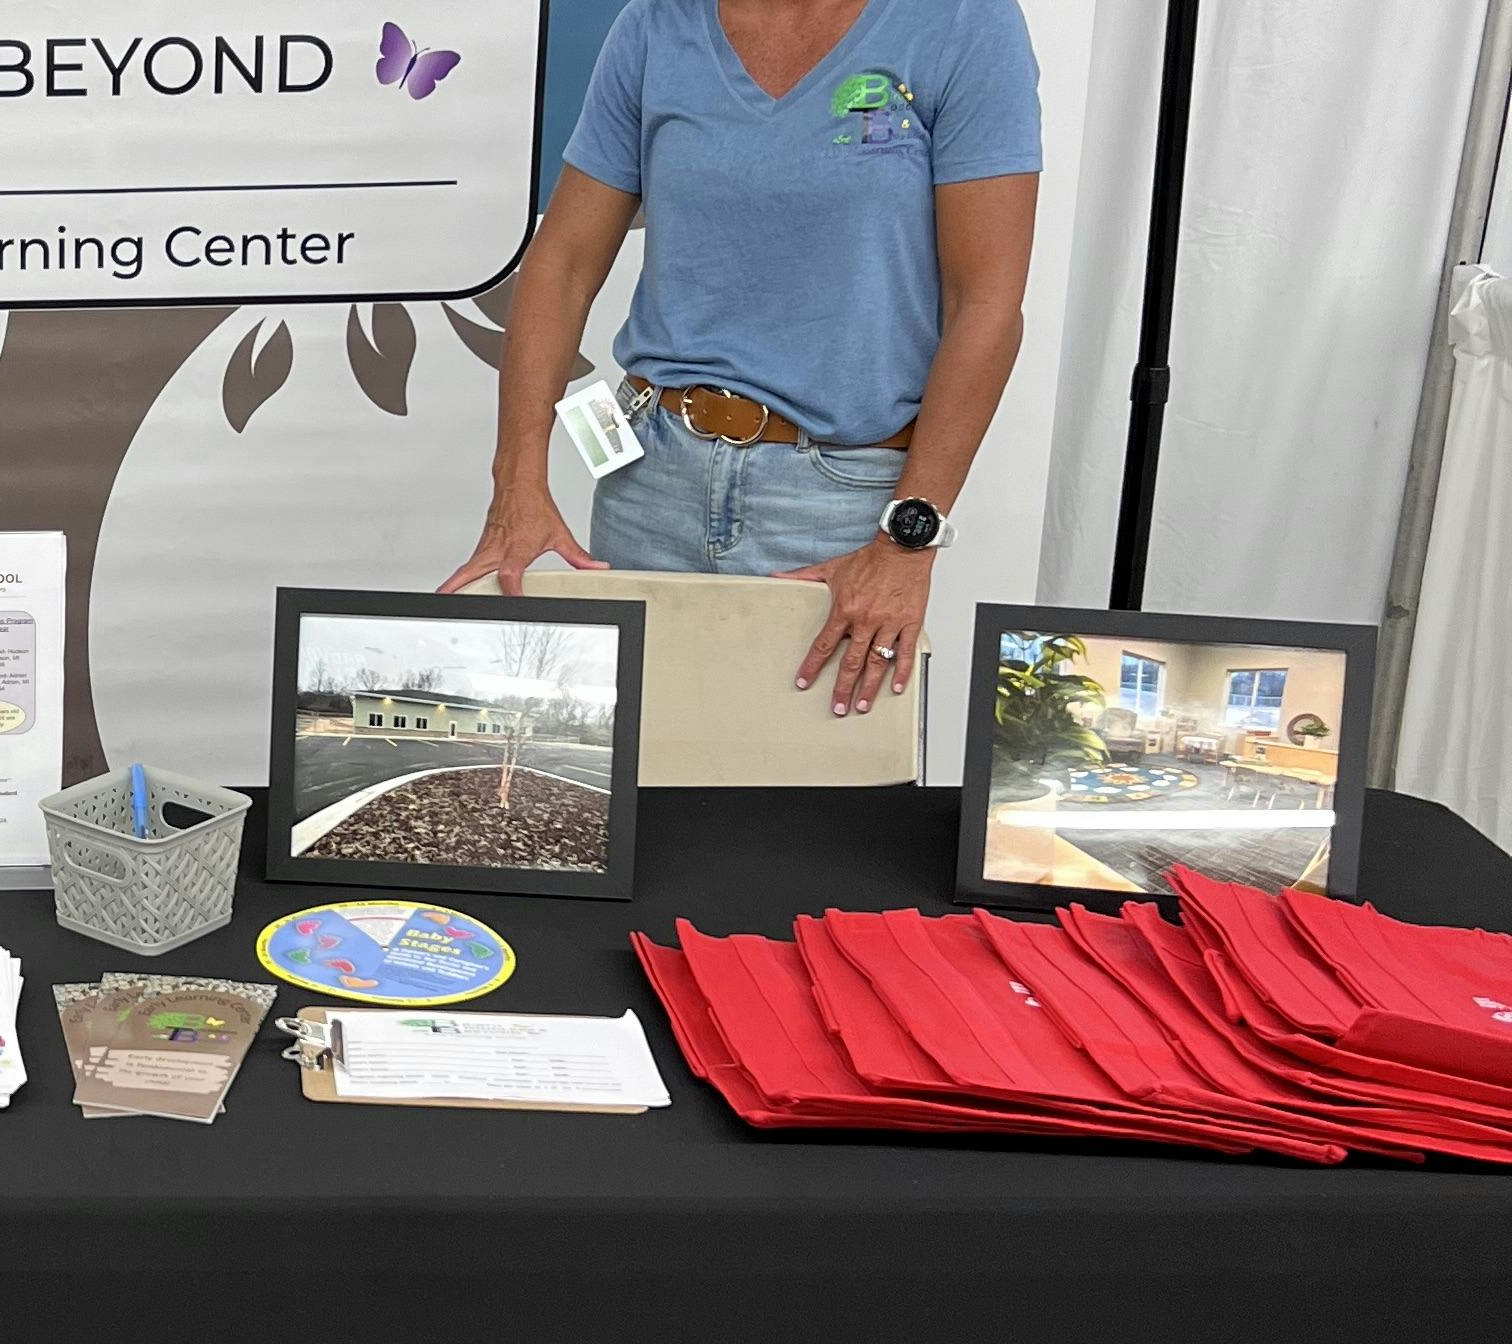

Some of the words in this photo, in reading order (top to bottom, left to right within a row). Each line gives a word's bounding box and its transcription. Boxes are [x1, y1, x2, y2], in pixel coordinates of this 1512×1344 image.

[165, 225, 355, 268] Center
[407, 929, 454, 945] Baby
[399, 938, 462, 956] Stages
